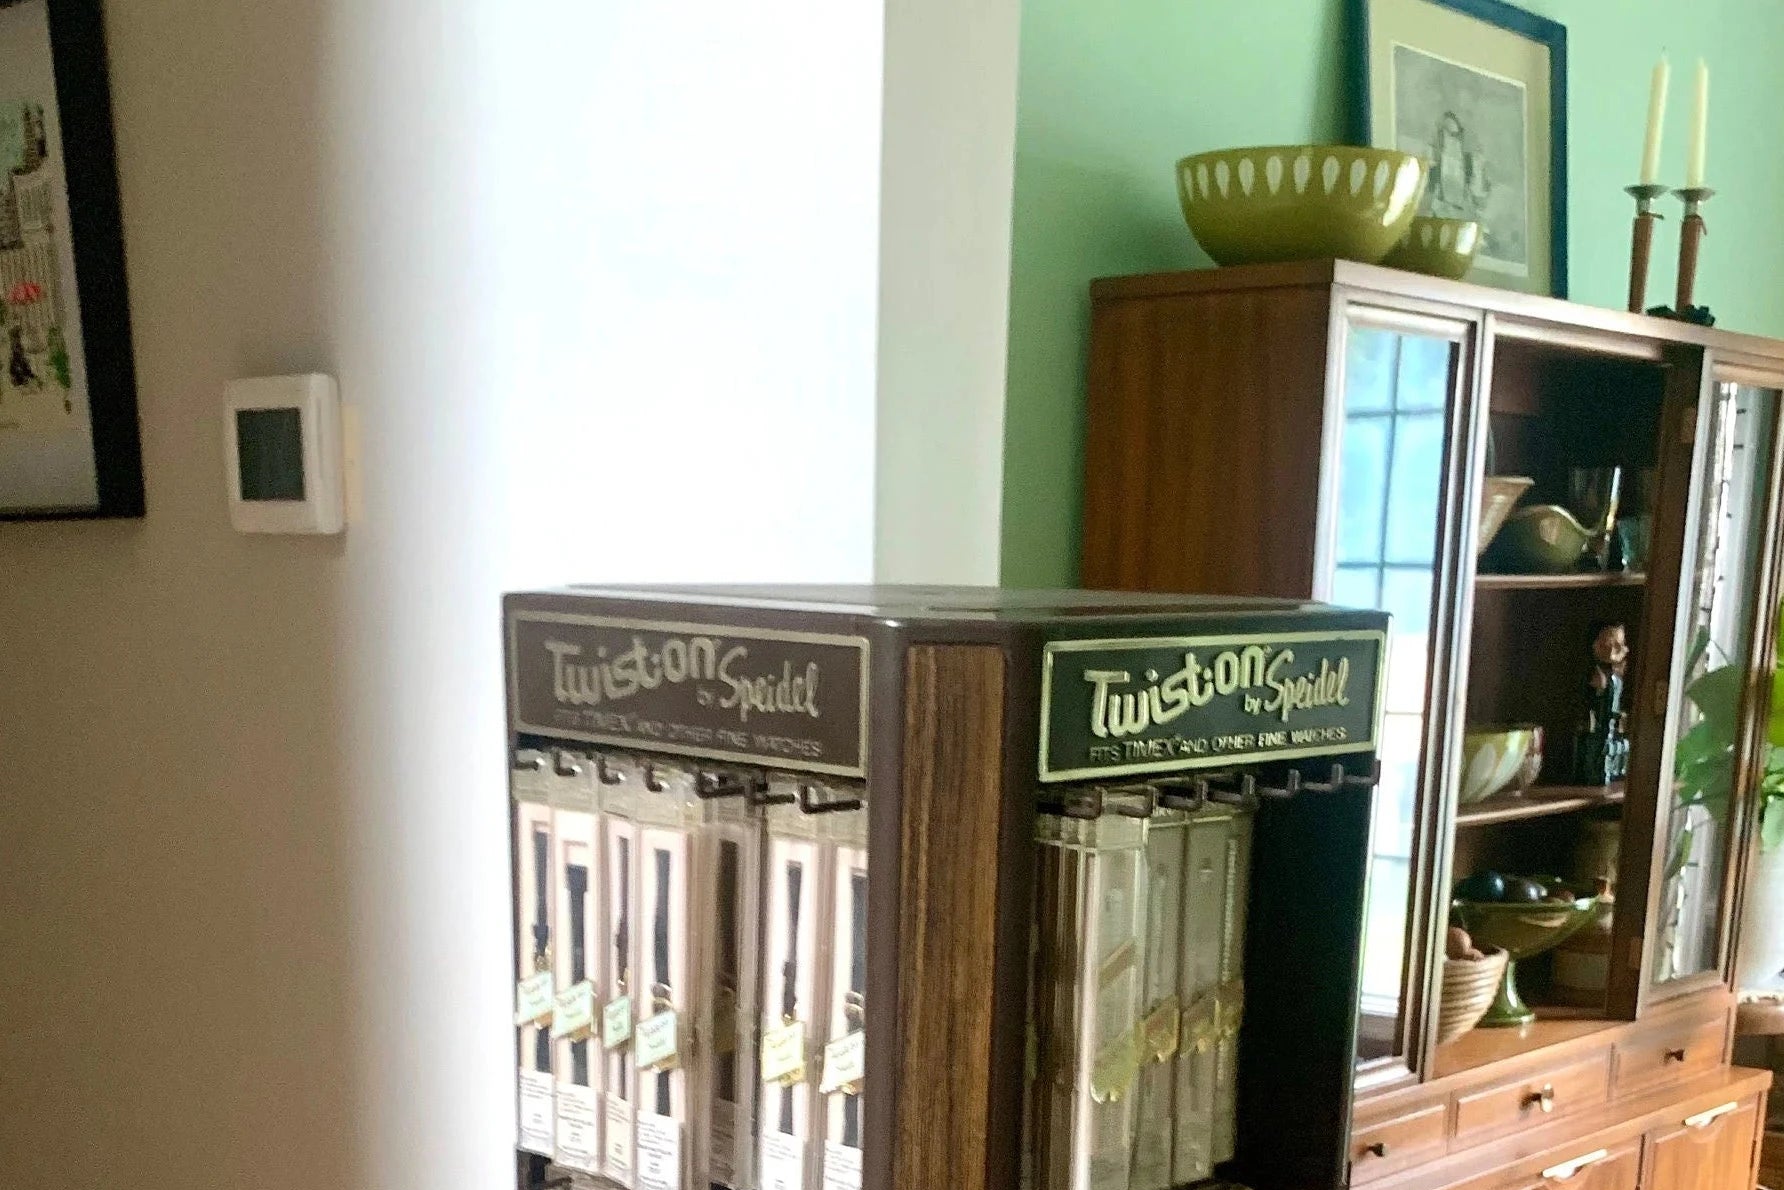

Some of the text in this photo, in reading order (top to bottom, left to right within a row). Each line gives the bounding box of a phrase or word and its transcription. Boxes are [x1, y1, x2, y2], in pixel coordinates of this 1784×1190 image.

[718, 646, 820, 722] Speidel
[1244, 693, 1262, 715] by
[1263, 648, 1350, 722] Speidel
[1258, 731, 1287, 748] FINE
[1290, 726, 1348, 744] WATCHES
